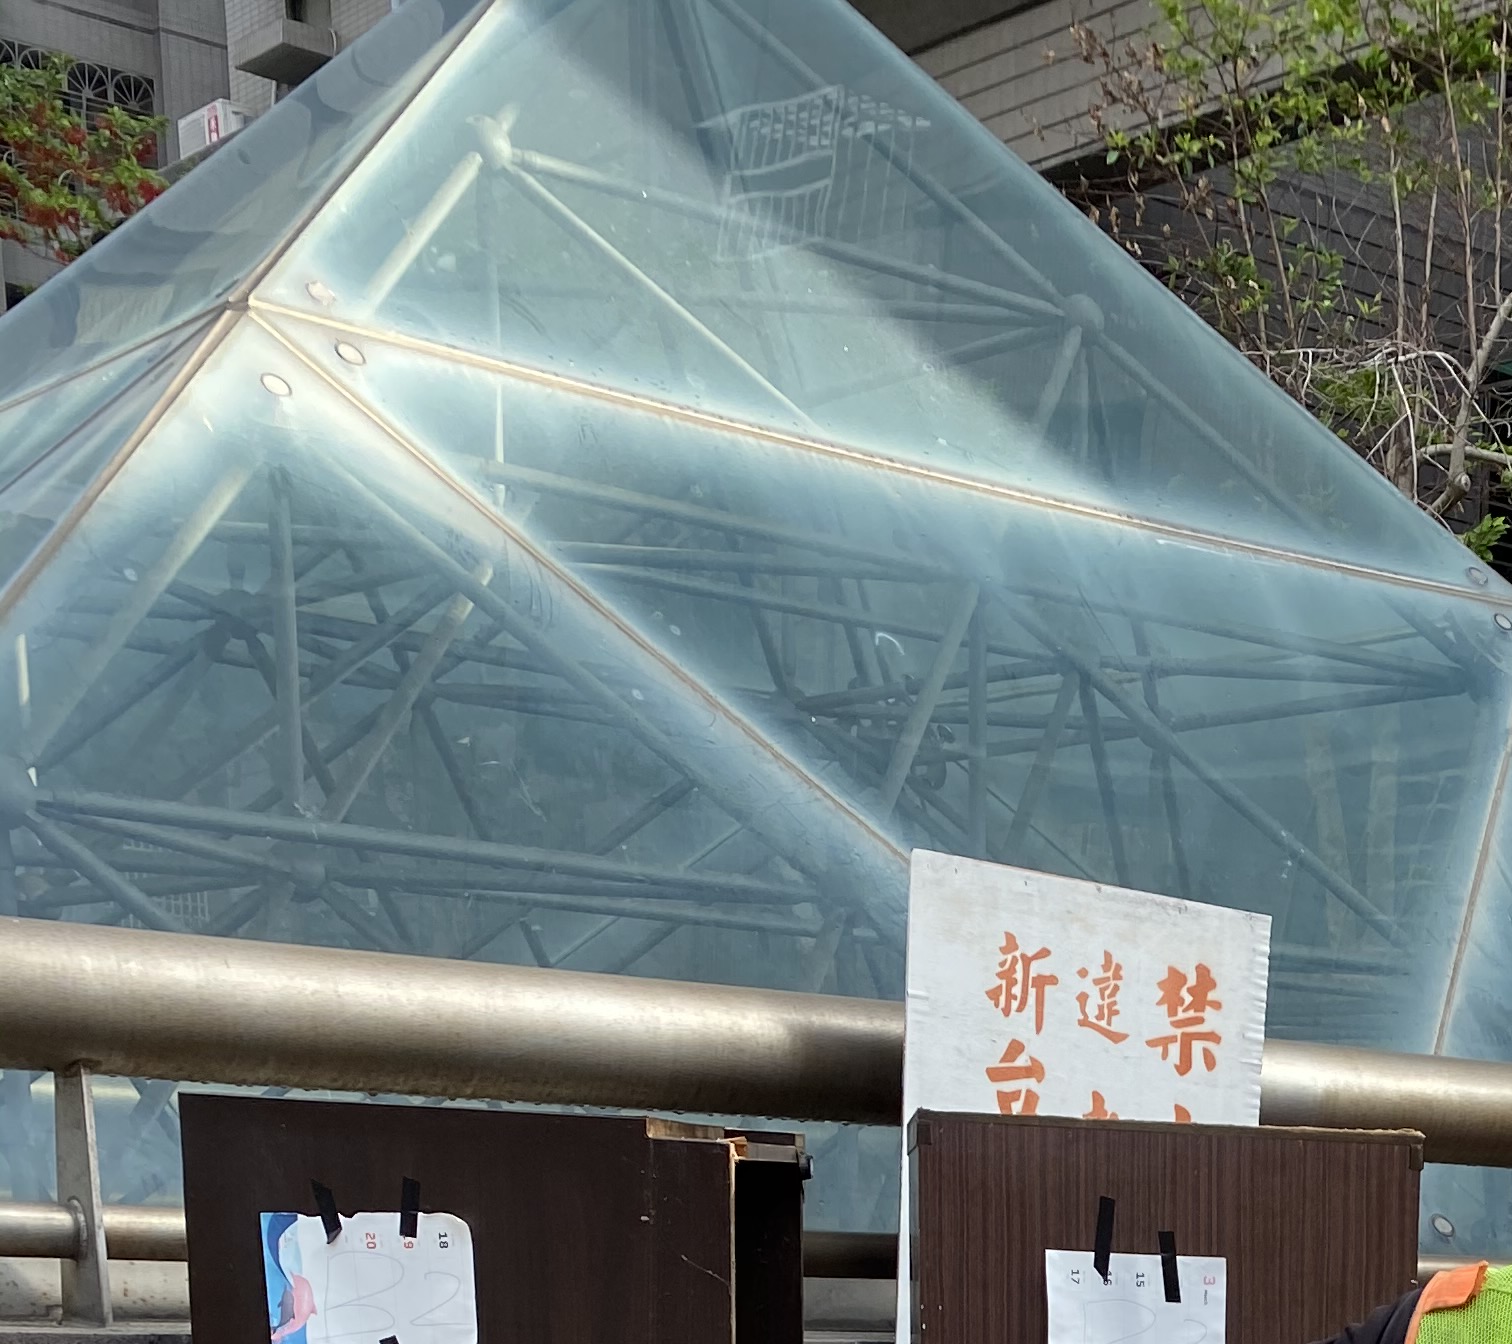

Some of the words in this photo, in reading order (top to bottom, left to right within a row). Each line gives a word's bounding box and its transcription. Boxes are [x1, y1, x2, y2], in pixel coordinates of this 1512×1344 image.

[365, 1231, 376, 1250] 20
[403, 1234, 414, 1250] 9
[438, 1231, 449, 1250] 18
[1070, 1269, 1080, 1285] 17
[1135, 1272, 1145, 1288] 15
[1203, 1275, 1216, 1286] 3
